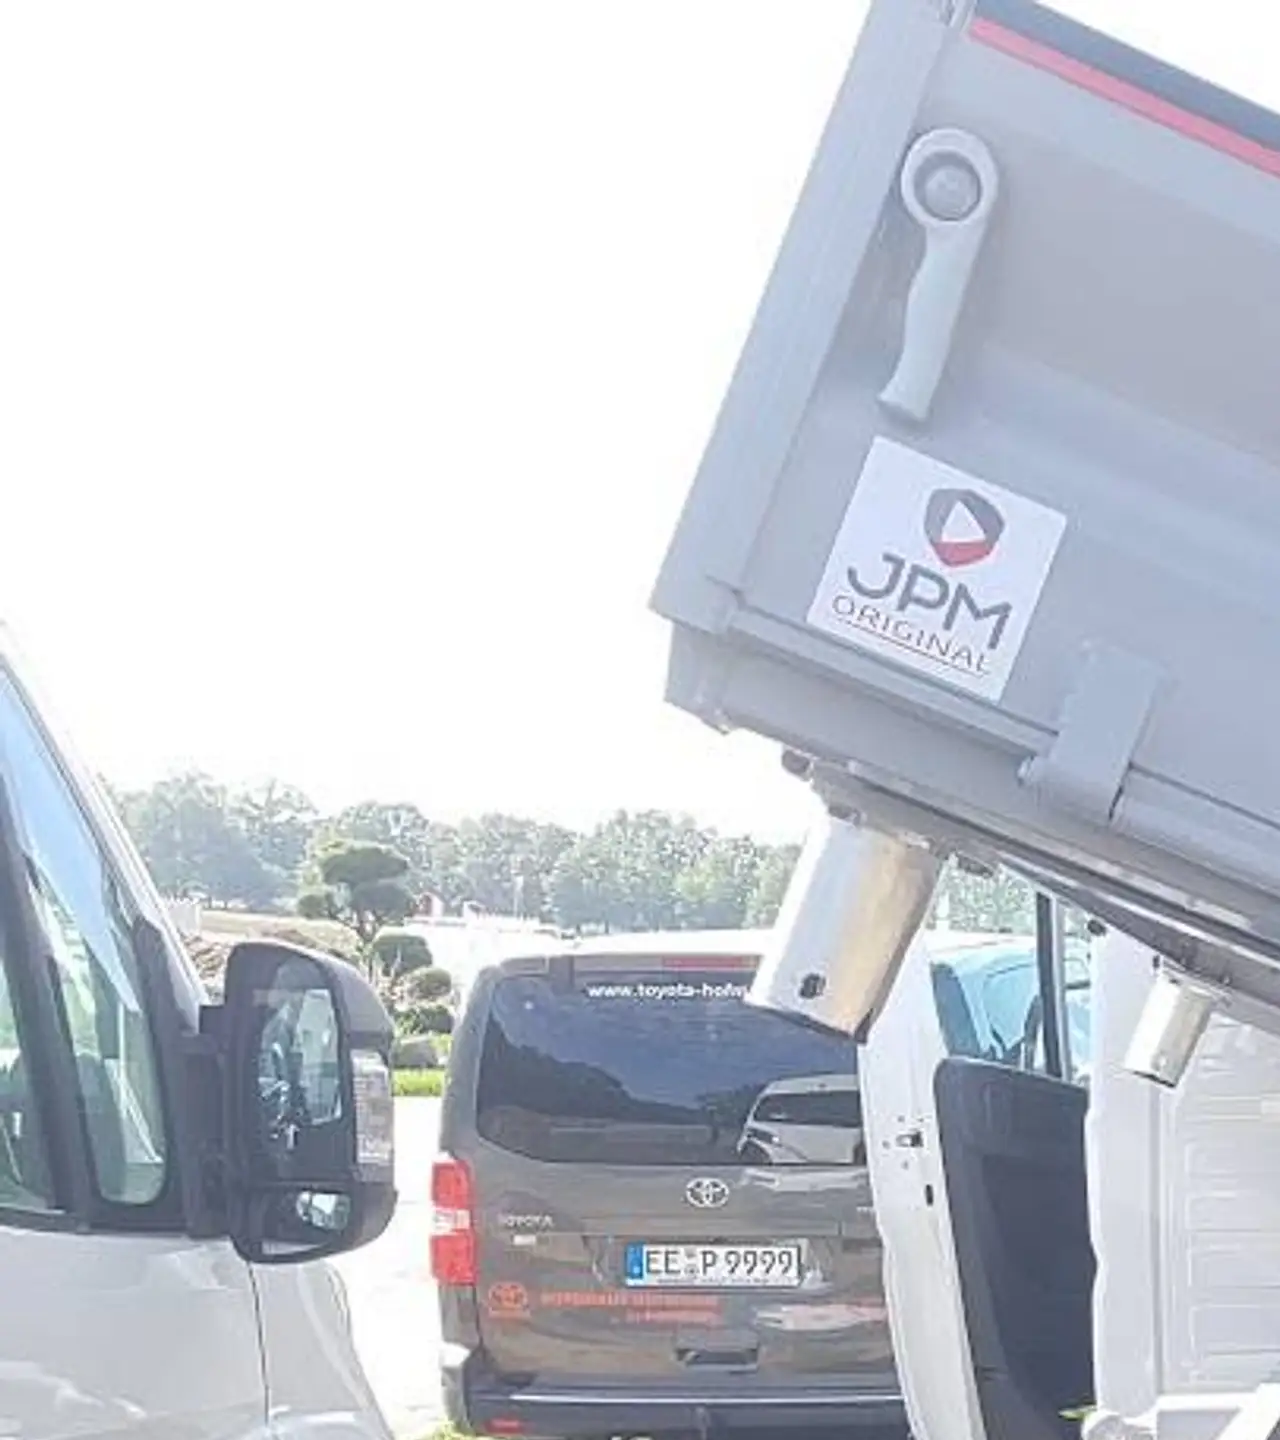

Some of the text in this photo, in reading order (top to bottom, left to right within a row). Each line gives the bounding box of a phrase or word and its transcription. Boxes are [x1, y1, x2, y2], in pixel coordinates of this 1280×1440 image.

[831, 594, 993, 673] ORIGINAL
[846, 552, 1013, 650] JPM
[645, 1250, 681, 1275] EE
